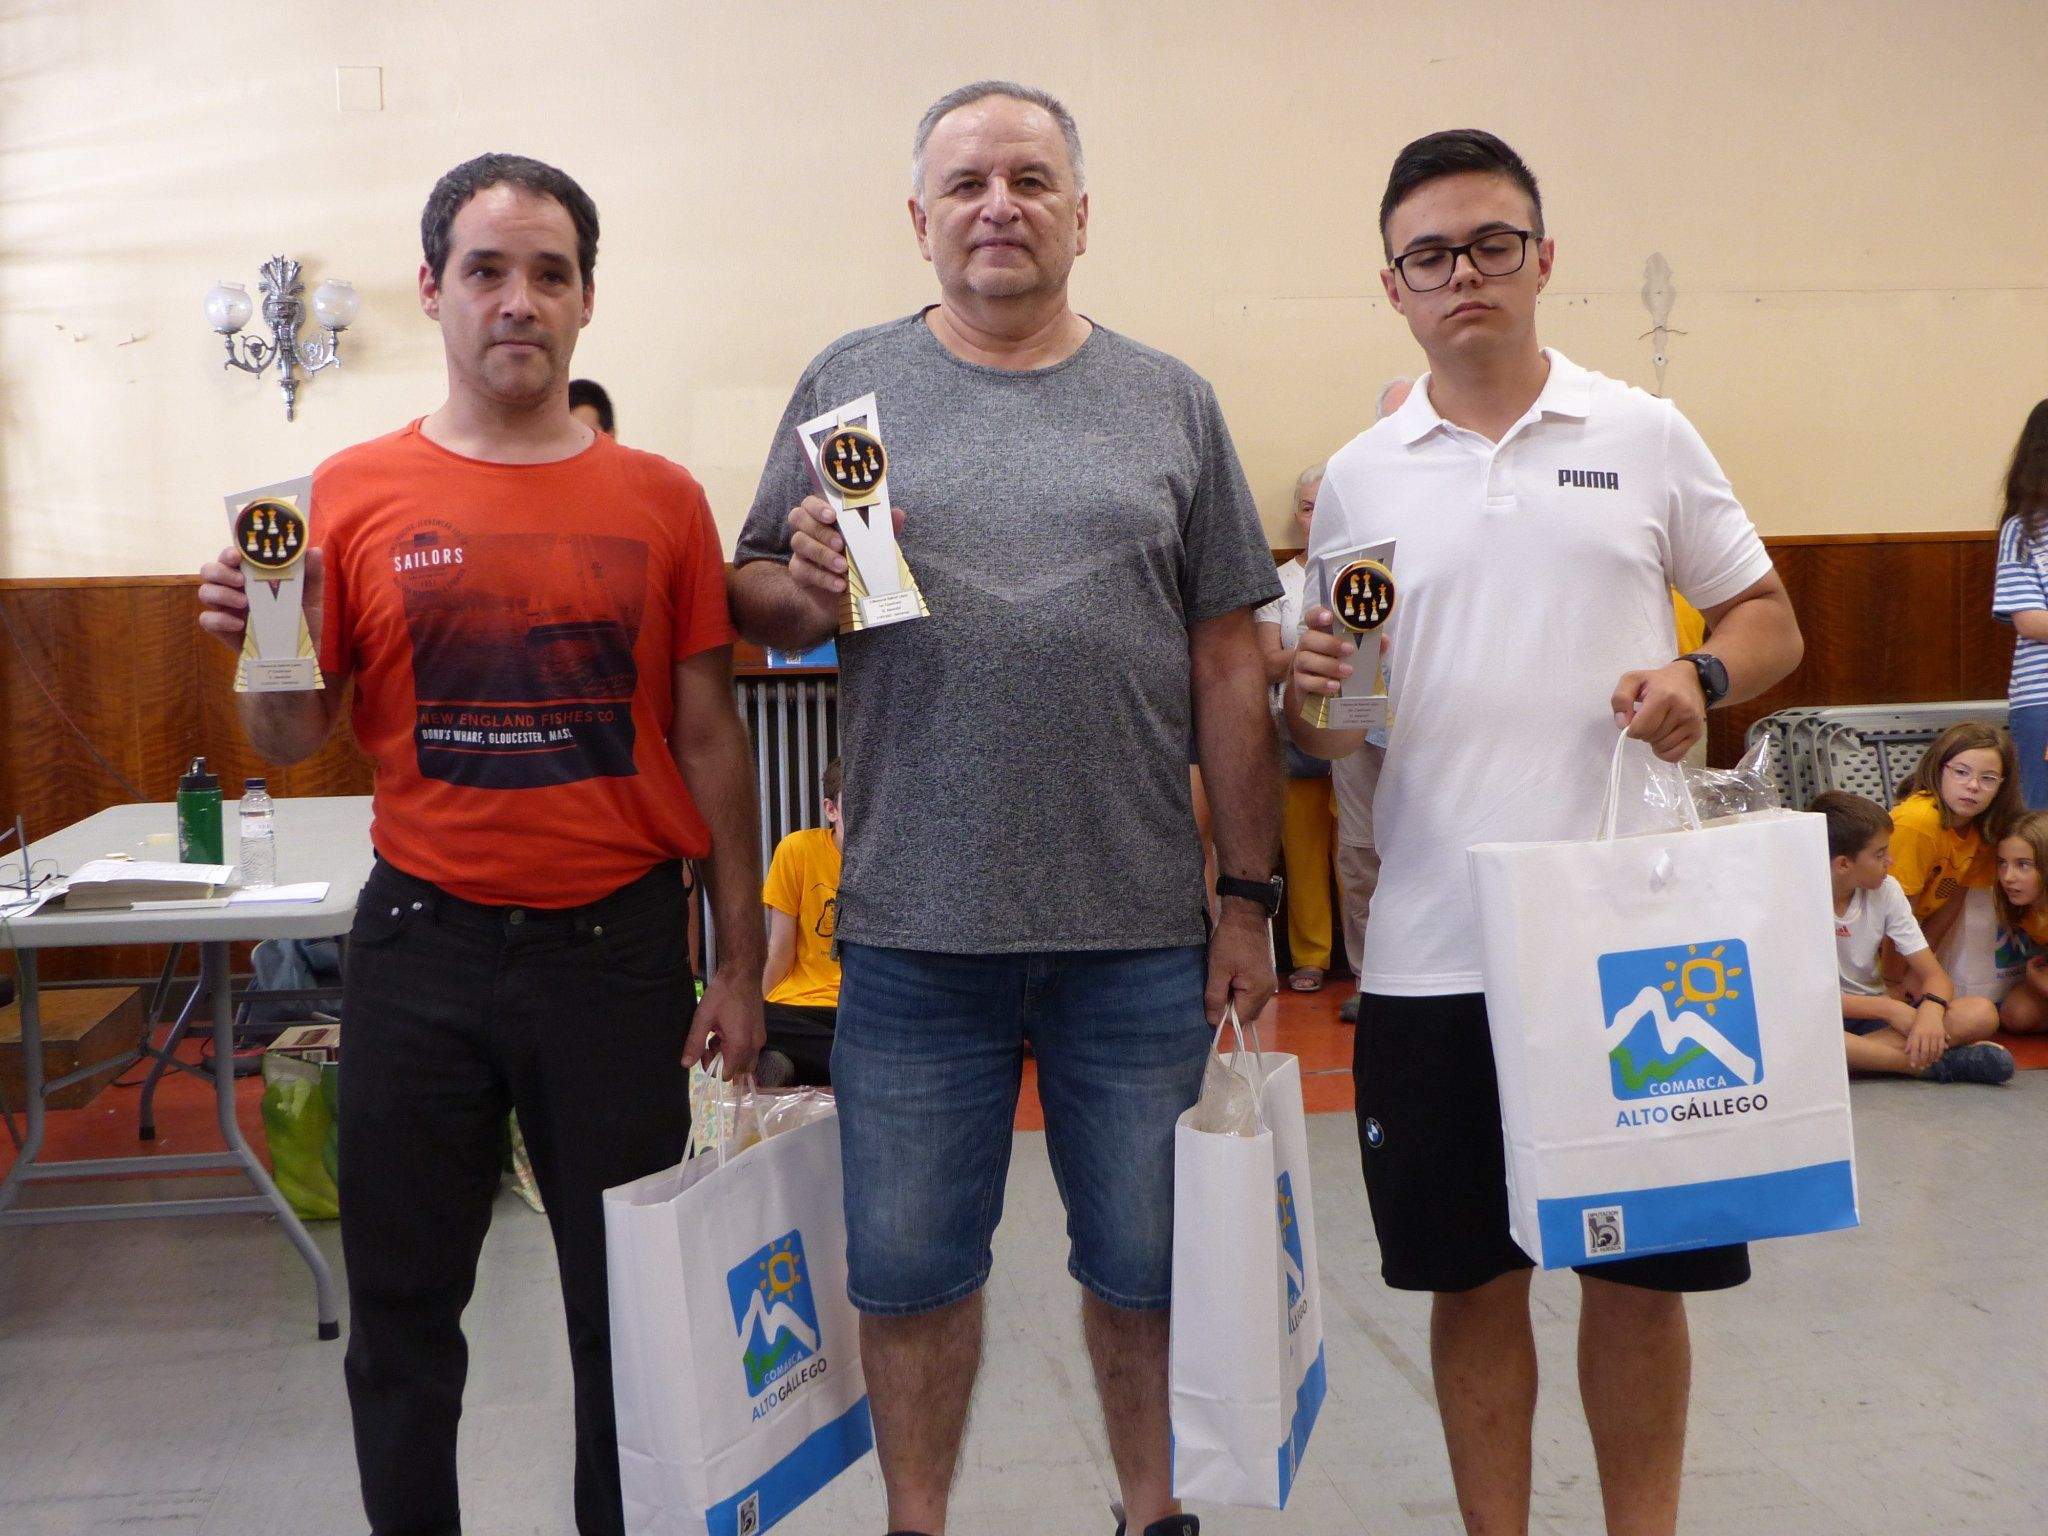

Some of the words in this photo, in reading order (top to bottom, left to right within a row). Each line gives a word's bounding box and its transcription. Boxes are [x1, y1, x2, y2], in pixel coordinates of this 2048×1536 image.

[1558, 469, 1619, 490] PUMA
[394, 547, 463, 572] SAILORS
[421, 712, 454, 725] NEW
[458, 712, 535, 727] ENGLAND
[542, 711, 593, 726] FISHES
[454, 730, 485, 744] WHARF,
[489, 732, 545, 744] GLOUCESTER,
[1649, 1075, 1727, 1096] COMARCA
[764, 1350, 804, 1384] COMARCA
